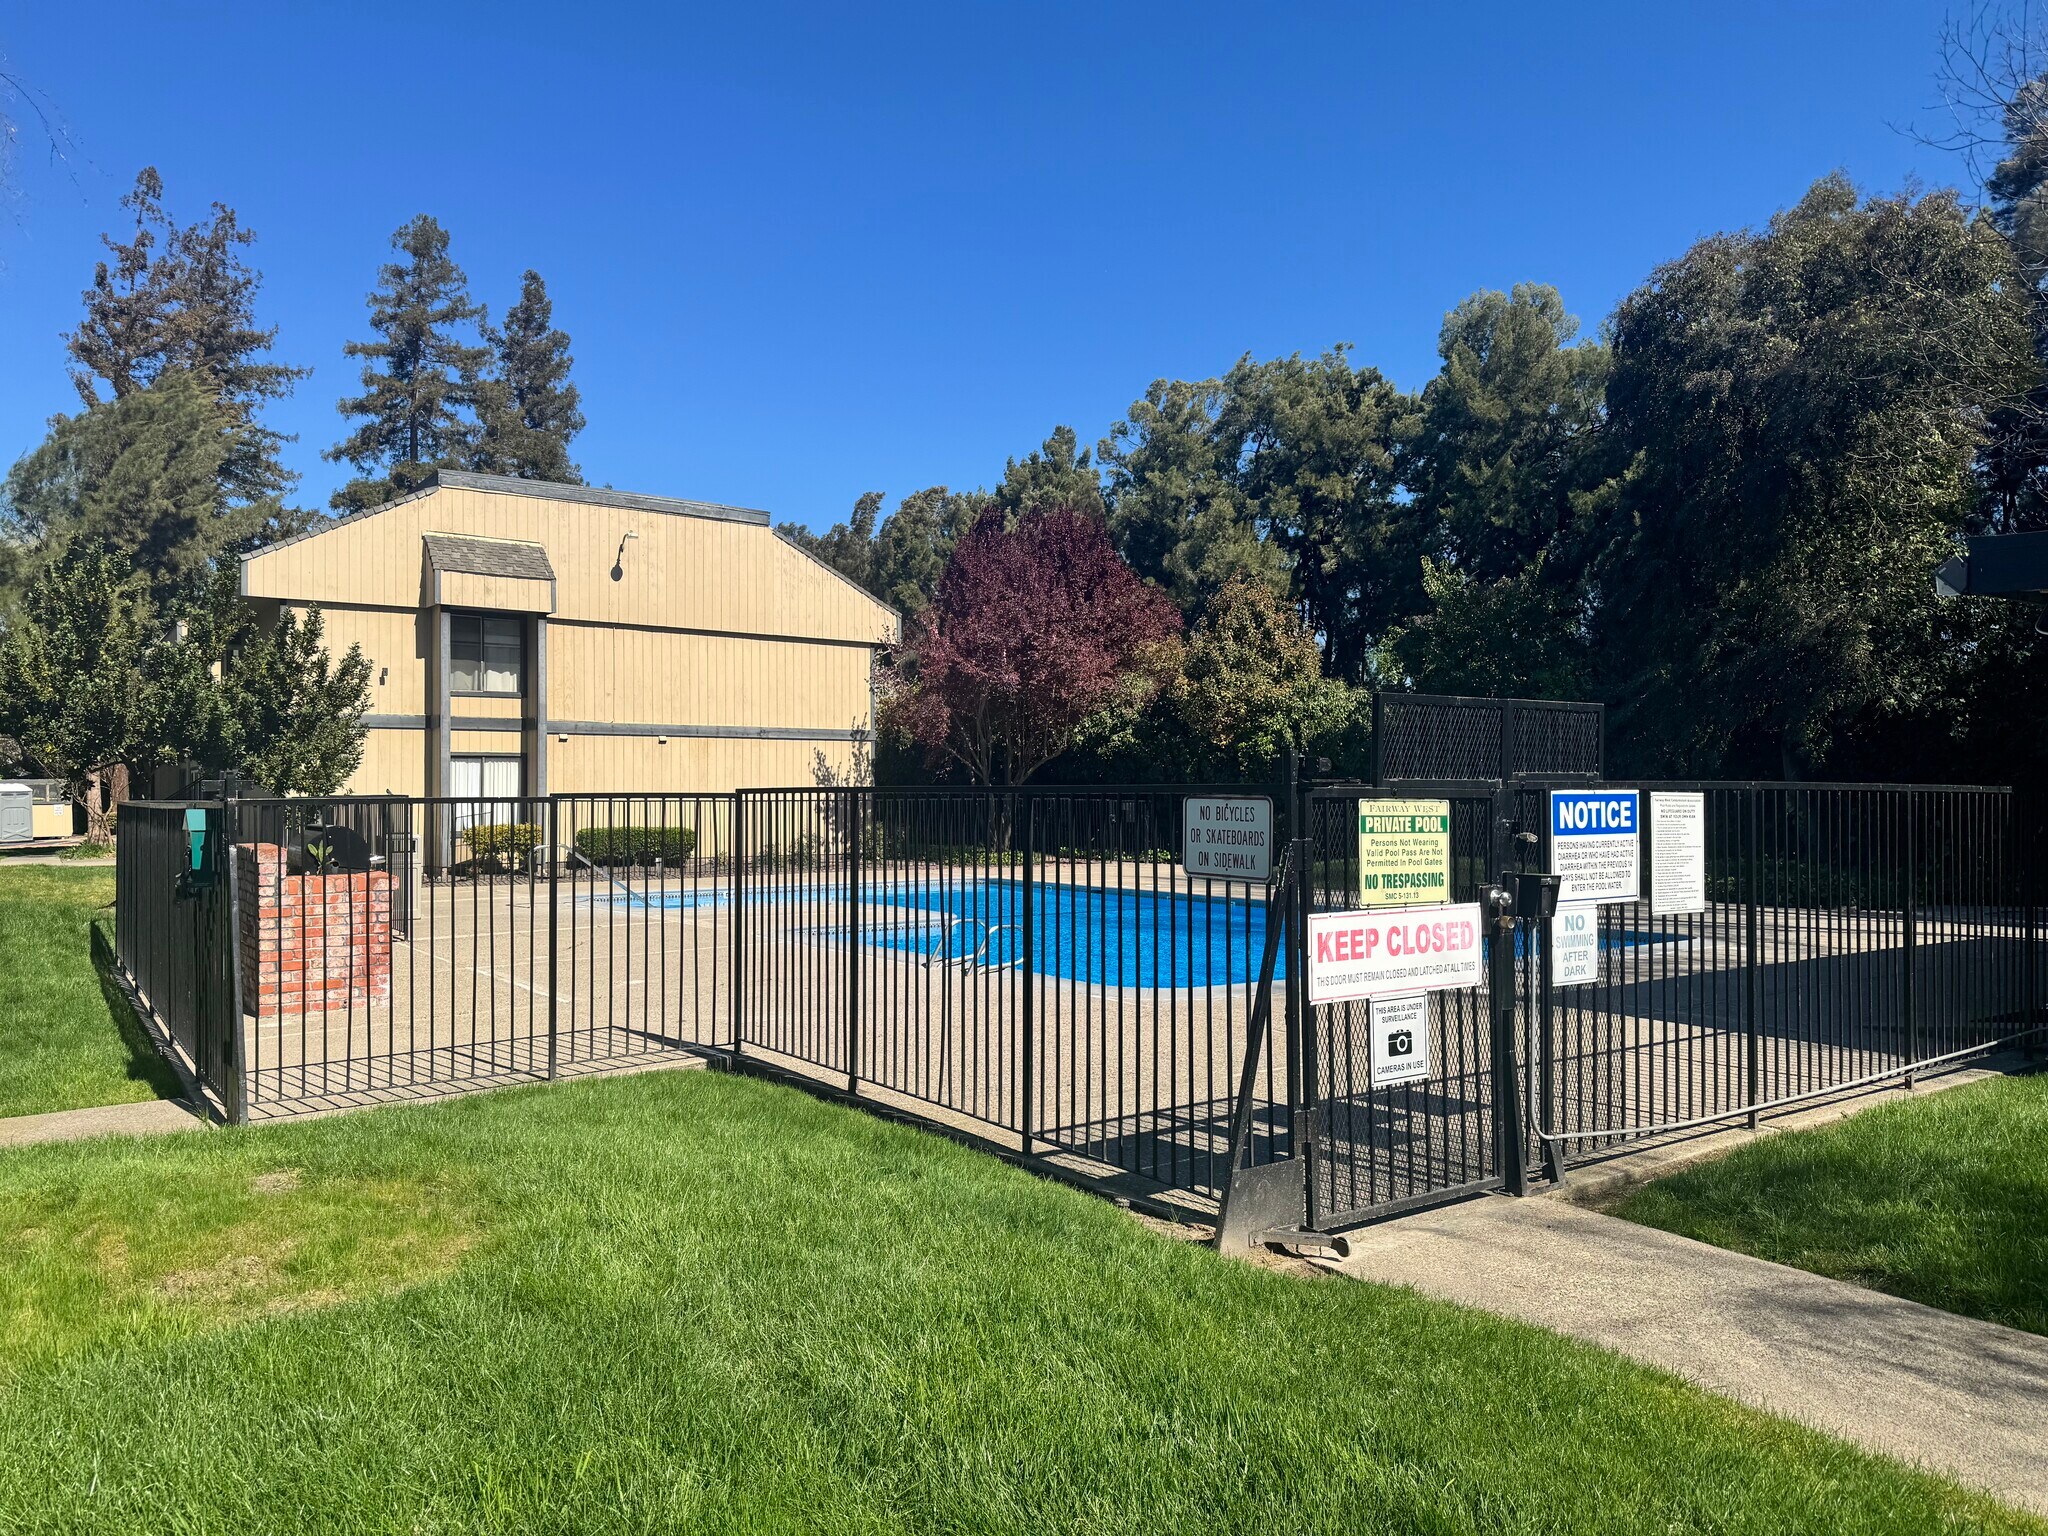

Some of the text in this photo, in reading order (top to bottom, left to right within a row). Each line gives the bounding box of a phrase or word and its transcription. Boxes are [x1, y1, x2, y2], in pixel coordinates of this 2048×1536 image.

[1200, 806, 1255, 822] NO BICYCLES
[1559, 801, 1632, 829] NOTICE
[1365, 816, 1443, 832] PRIVATE POOL
[1191, 828, 1264, 846] OR SKATEBOARDS
[1413, 838, 1438, 847] Wearing
[1558, 842, 1578, 850] PERSONS
[1596, 840, 1619, 848] CURRENTLY
[1198, 851, 1256, 870] ON SIDEWALK
[1558, 852, 1580, 860] DIARRHEA
[1560, 863, 1582, 871] DIARRHEA
[1607, 860, 1627, 868] PREVIOUS
[1365, 872, 1444, 889] NO TRESPASSING
[1575, 873, 1588, 881] SHALL
[1605, 871, 1625, 879] ALLOWED
[1572, 883, 1585, 892] ENTER
[1565, 915, 1585, 931] NO
[1317, 921, 1474, 963] KEEP CLOSED
[1556, 933, 1594, 949] SWIMMING
[1563, 951, 1588, 963] AFTER
[1317, 961, 1475, 987] THIS DOOR MUST REMAIN CLOSED AND LATCHED AT ALL TIMES
[1564, 964, 1586, 976] DARK
[1406, 1002, 1422, 1011] UNDER
[1382, 1013, 1417, 1023] SURVEILLANCE
[1377, 1063, 1405, 1074] CAMERAS
[1413, 1060, 1424, 1068] USE
